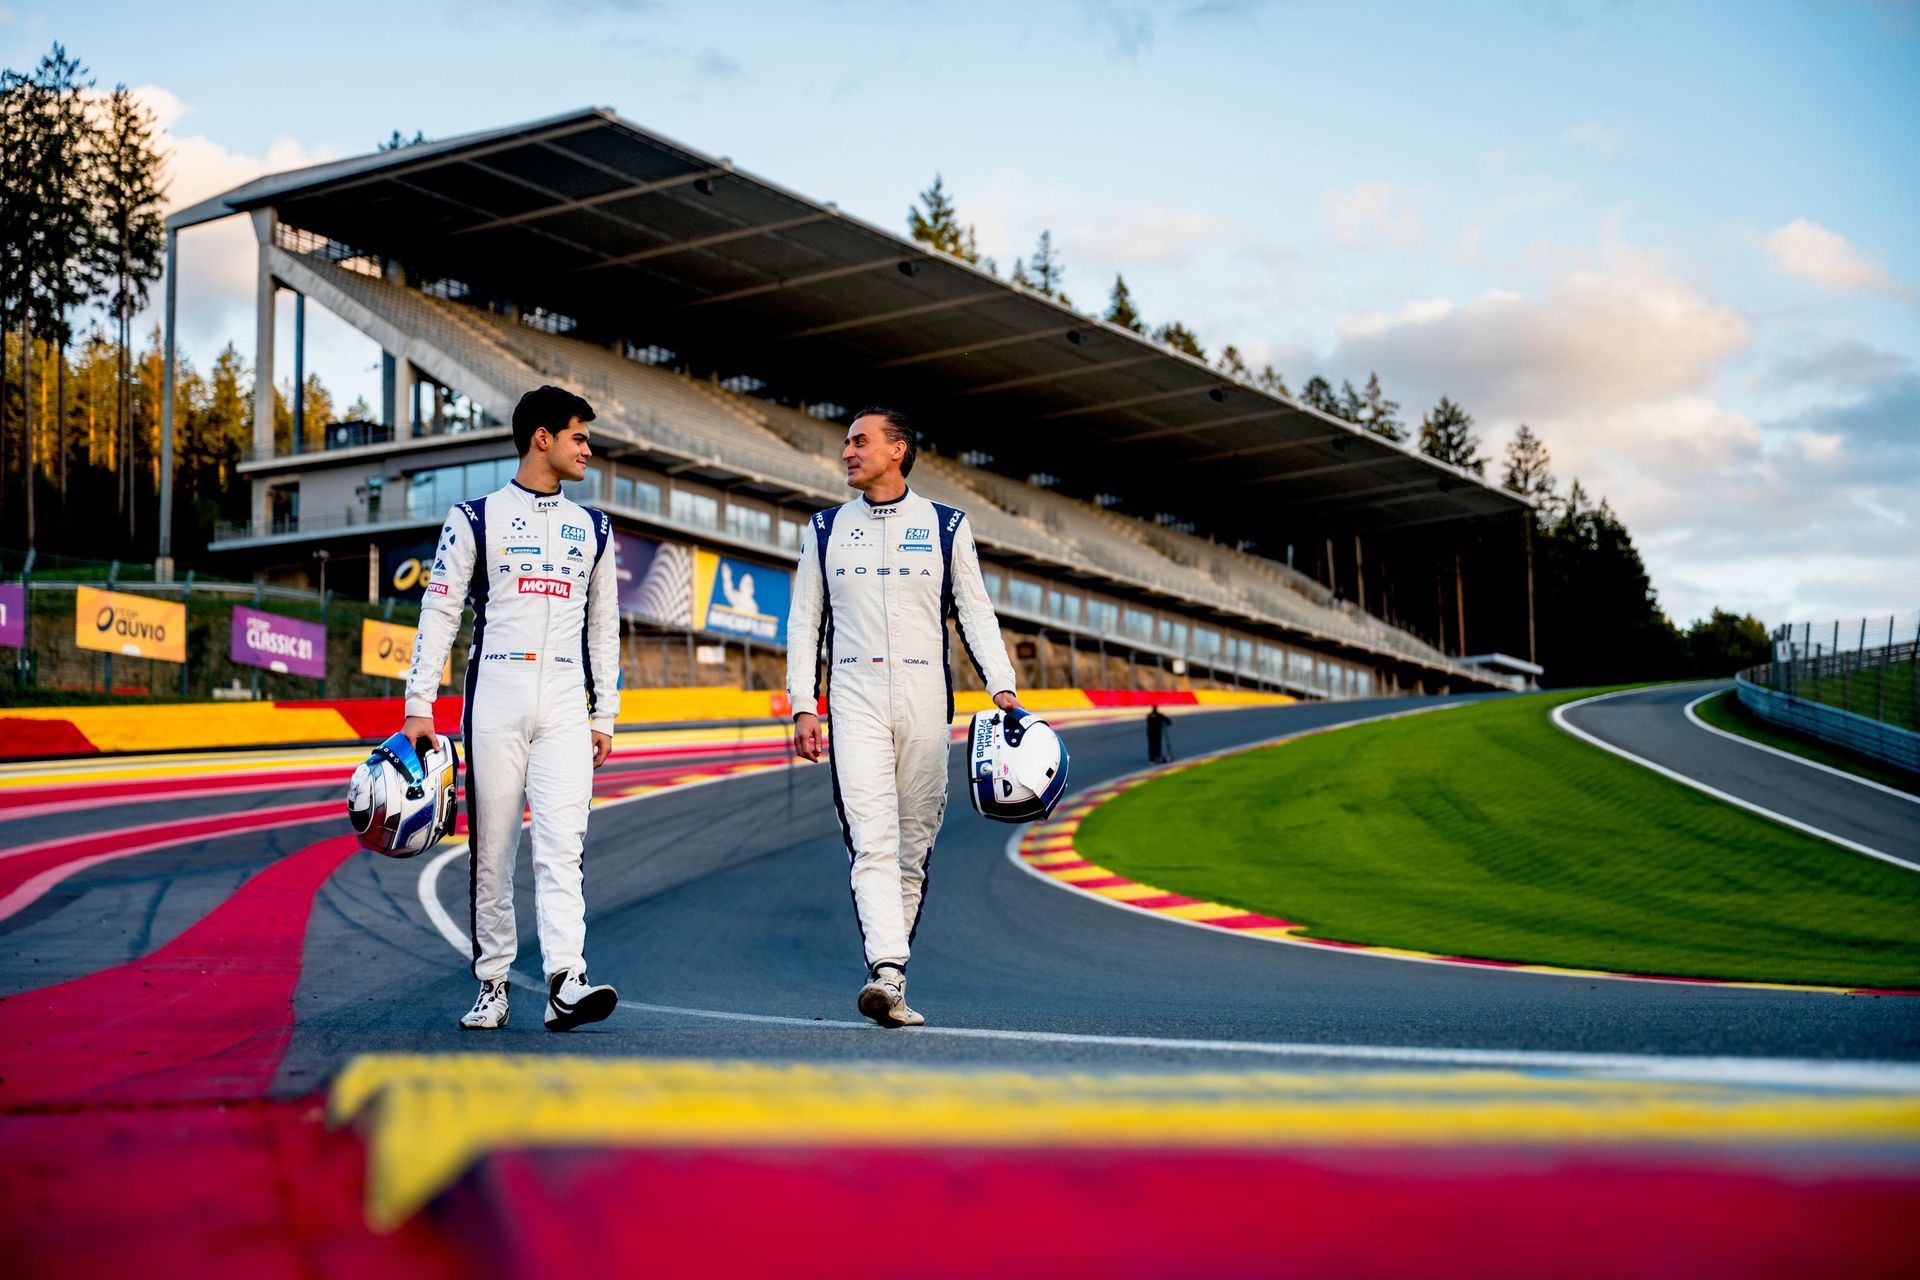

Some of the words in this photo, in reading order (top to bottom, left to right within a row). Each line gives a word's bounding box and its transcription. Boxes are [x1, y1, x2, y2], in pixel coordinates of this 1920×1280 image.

[815, 511, 825, 530] HRX
[947, 511, 961, 532] HRX
[562, 526, 585, 537] 24H
[907, 528, 929, 537] 24H
[500, 563, 585, 578] ROSSA
[836, 567, 931, 576] ROSSA
[429, 584, 447, 594] OTUL
[520, 580, 568, 597] MOTUL
[116, 619, 165, 641] auvio
[246, 628, 298, 657] CLASSIC
[976, 719, 986, 759] РУСИНОВ
